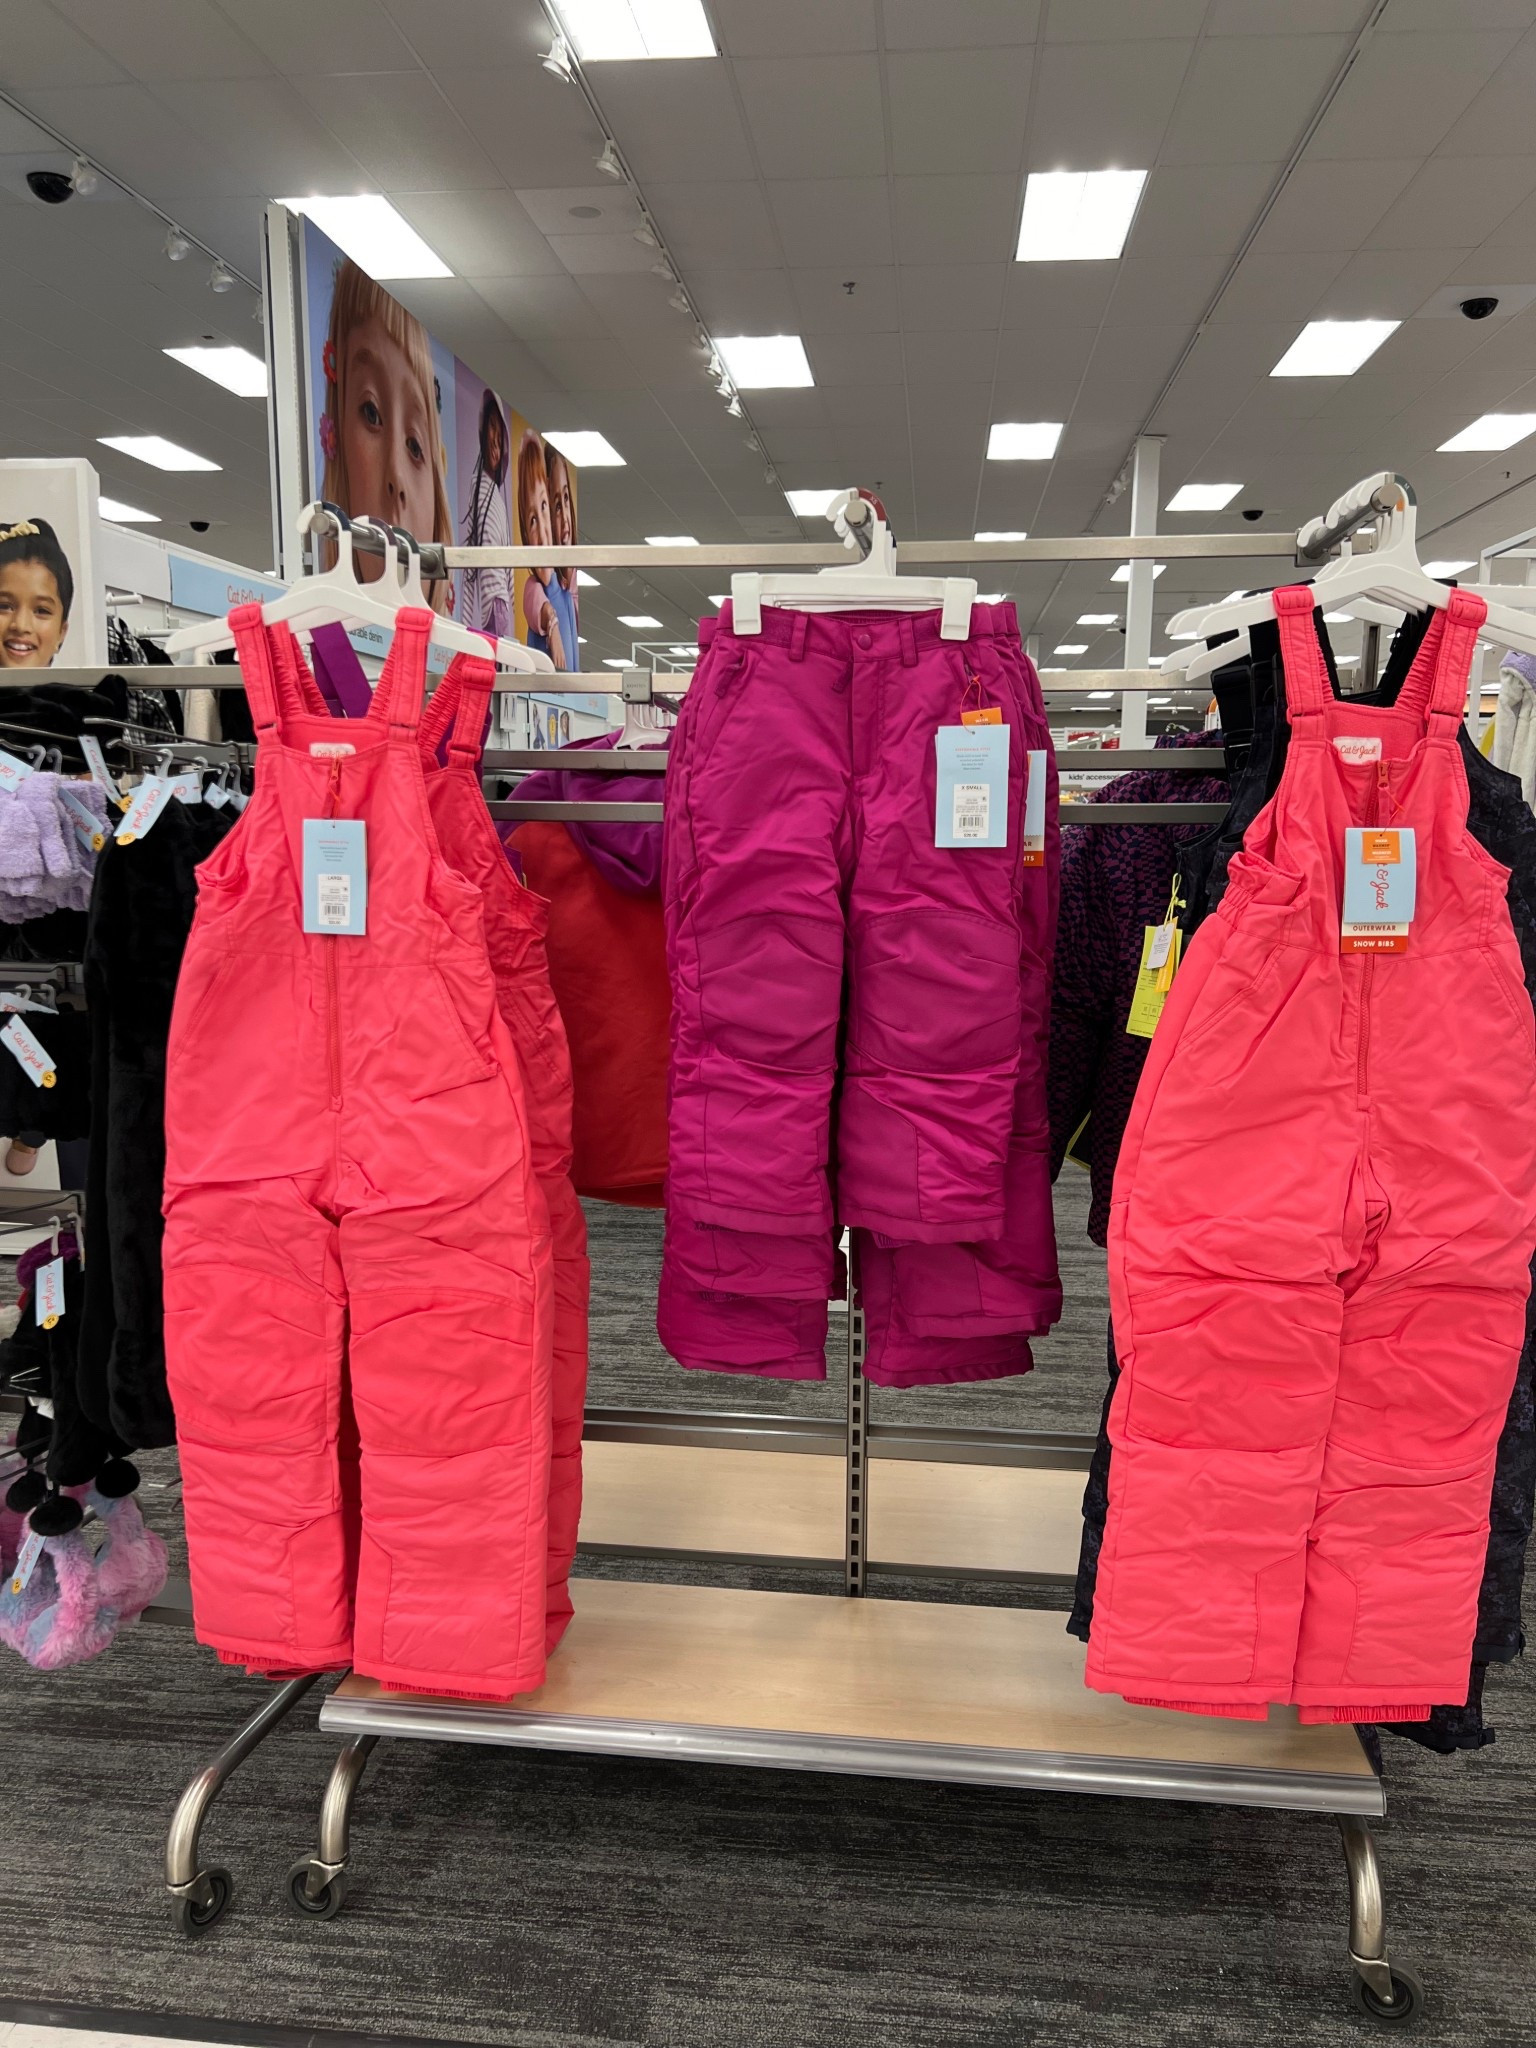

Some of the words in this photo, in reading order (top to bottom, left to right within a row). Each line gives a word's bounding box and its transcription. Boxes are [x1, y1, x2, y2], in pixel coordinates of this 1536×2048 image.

[227, 585, 240, 605] Cat
[1341, 745, 1351, 754] Cat
[1358, 746, 1377, 759] Jack
[1370, 881, 1389, 910] Jack
[1352, 924, 1397, 932] OUTERWEAR
[1353, 940, 1376, 948] SNOW
